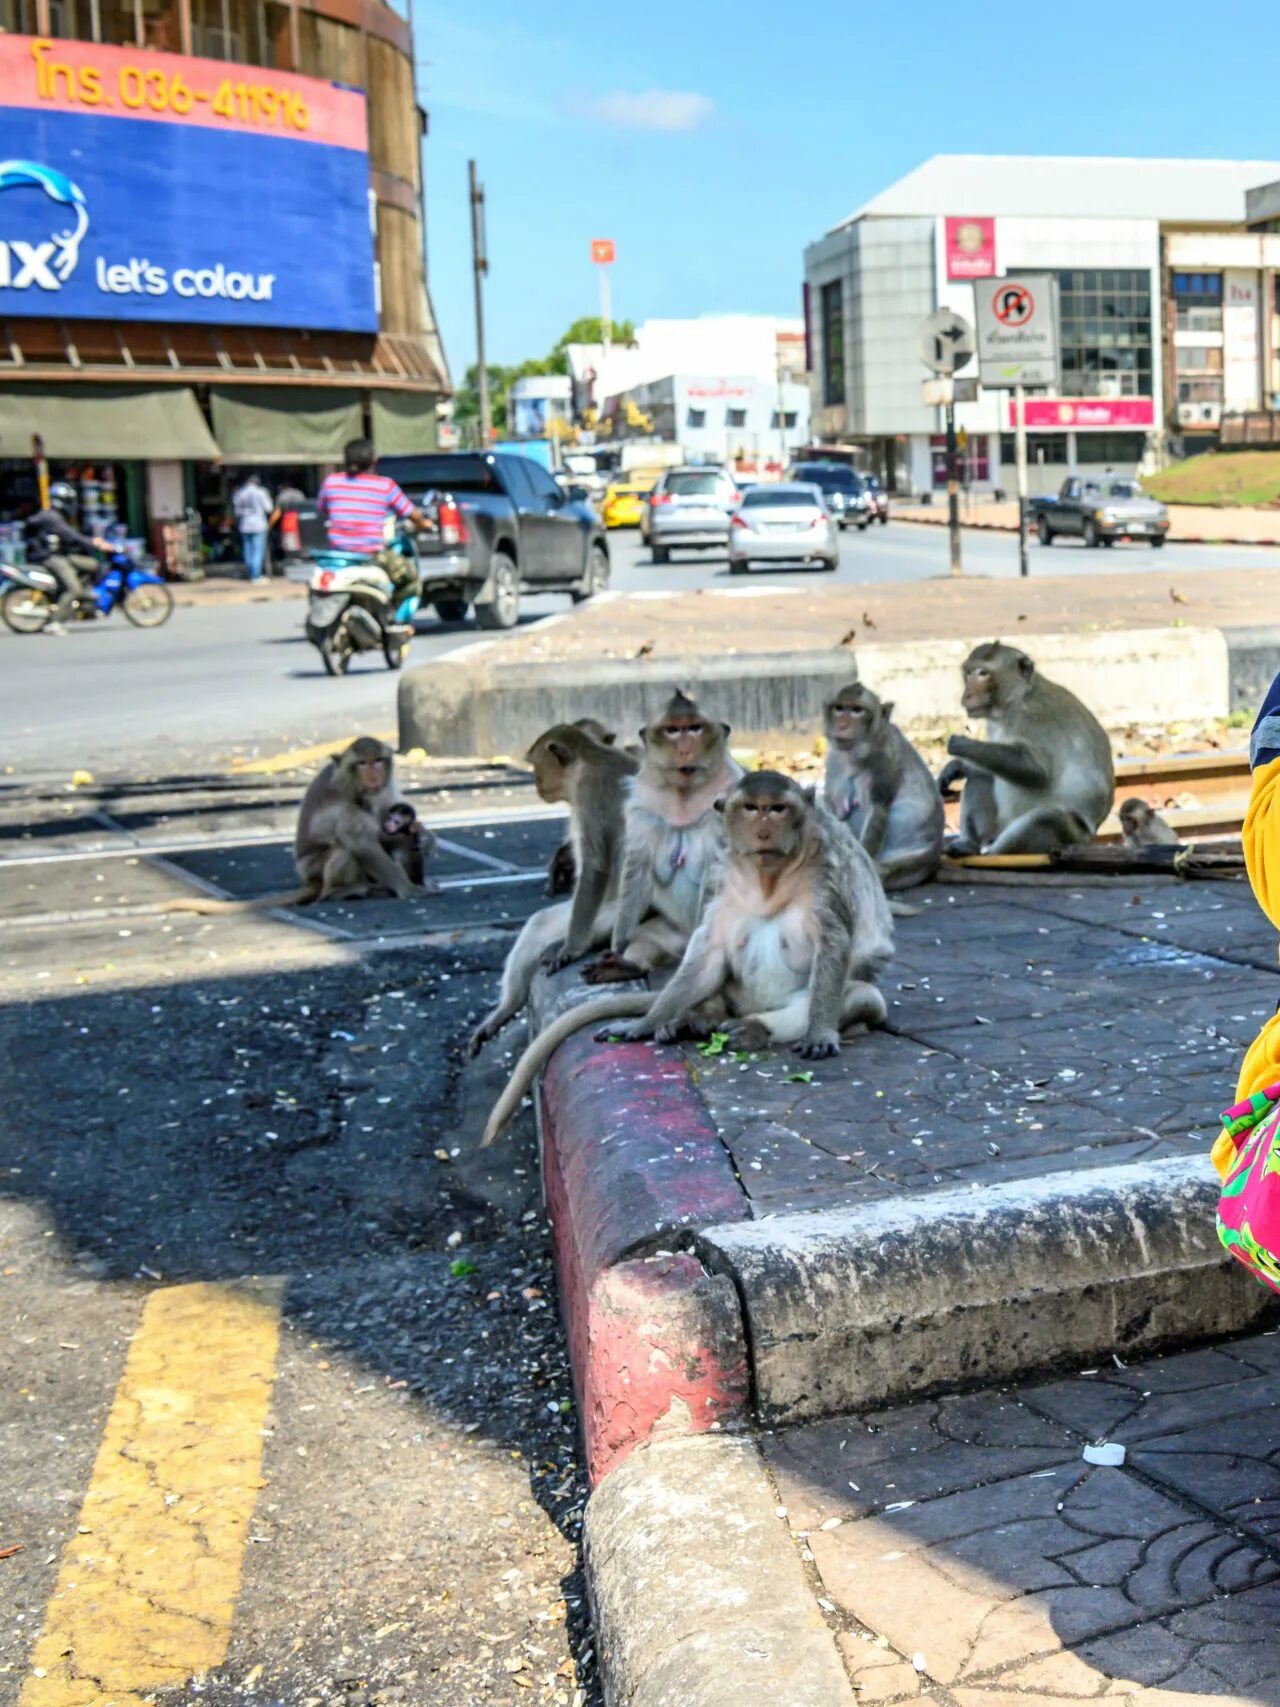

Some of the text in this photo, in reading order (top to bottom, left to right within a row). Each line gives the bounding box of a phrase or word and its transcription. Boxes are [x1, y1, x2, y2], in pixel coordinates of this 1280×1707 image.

[119, 66, 310, 130] 036-411916
[96, 256, 169, 297] let's
[172, 263, 276, 301] colour
